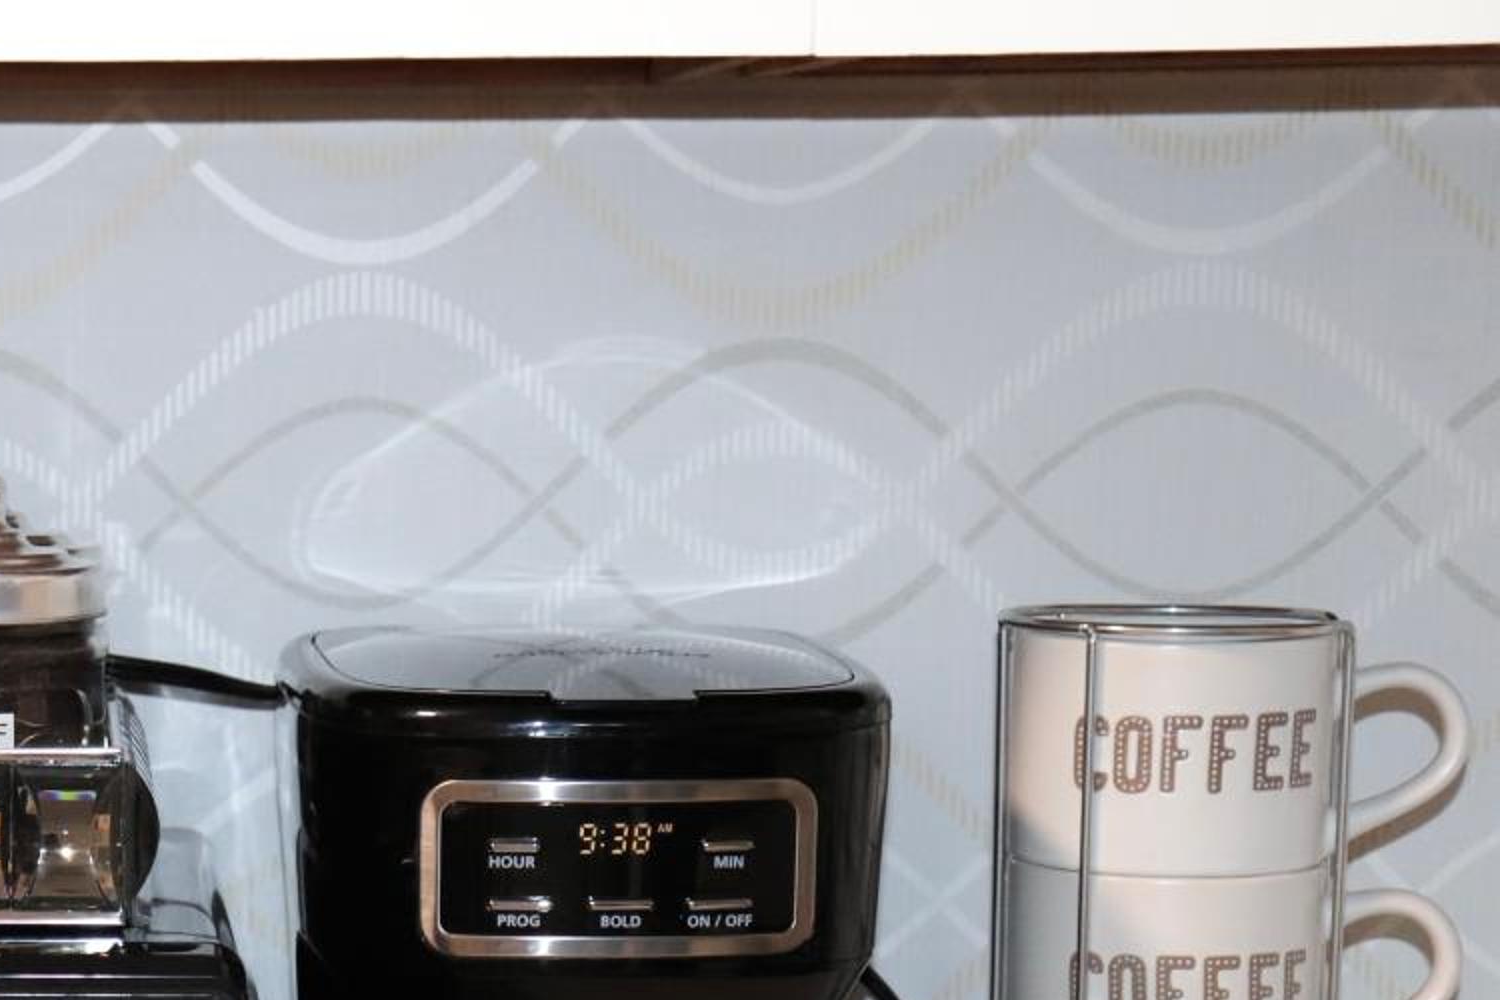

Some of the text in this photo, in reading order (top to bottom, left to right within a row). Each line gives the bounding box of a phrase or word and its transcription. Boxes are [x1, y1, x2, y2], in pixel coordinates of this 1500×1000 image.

[1073, 709, 1317, 793] COFFEE
[579, 823, 673, 854] 9:38 AM
[488, 856, 536, 869] HOUR
[713, 856, 745, 869] MIN
[497, 914, 541, 928] PROG
[600, 915, 642, 928] BOLD
[687, 915, 711, 928] ON
[725, 914, 753, 927] OFF
